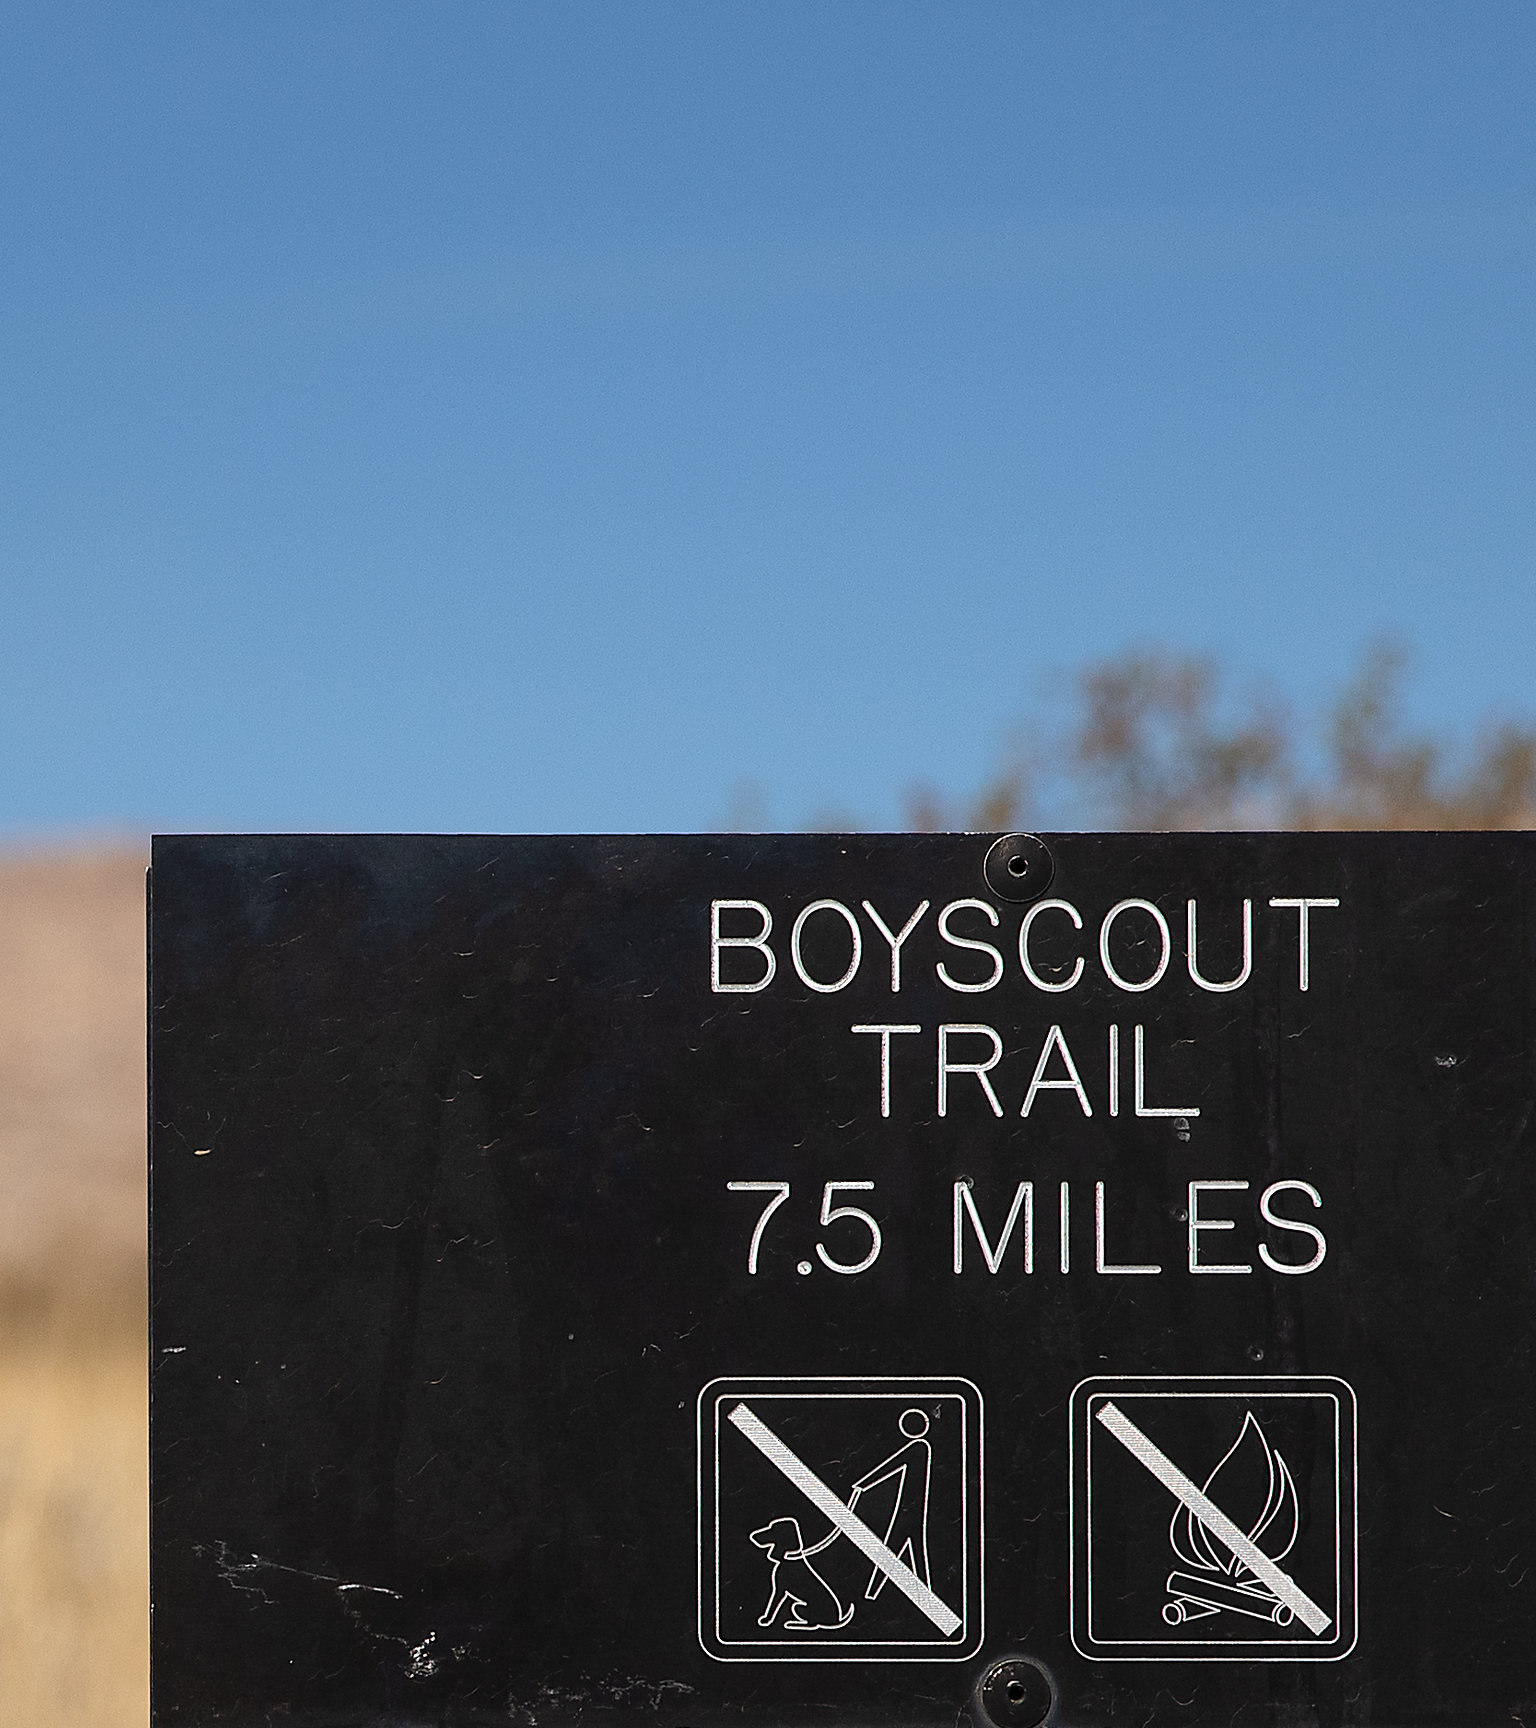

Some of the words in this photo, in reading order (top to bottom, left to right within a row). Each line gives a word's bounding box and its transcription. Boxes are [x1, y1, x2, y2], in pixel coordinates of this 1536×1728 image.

[710, 896, 1340, 993] BOYSCOUT
[850, 1023, 1201, 1118] TRAIL
[726, 1180, 882, 1276] 7.5
[953, 1179, 1327, 1275] MILES
